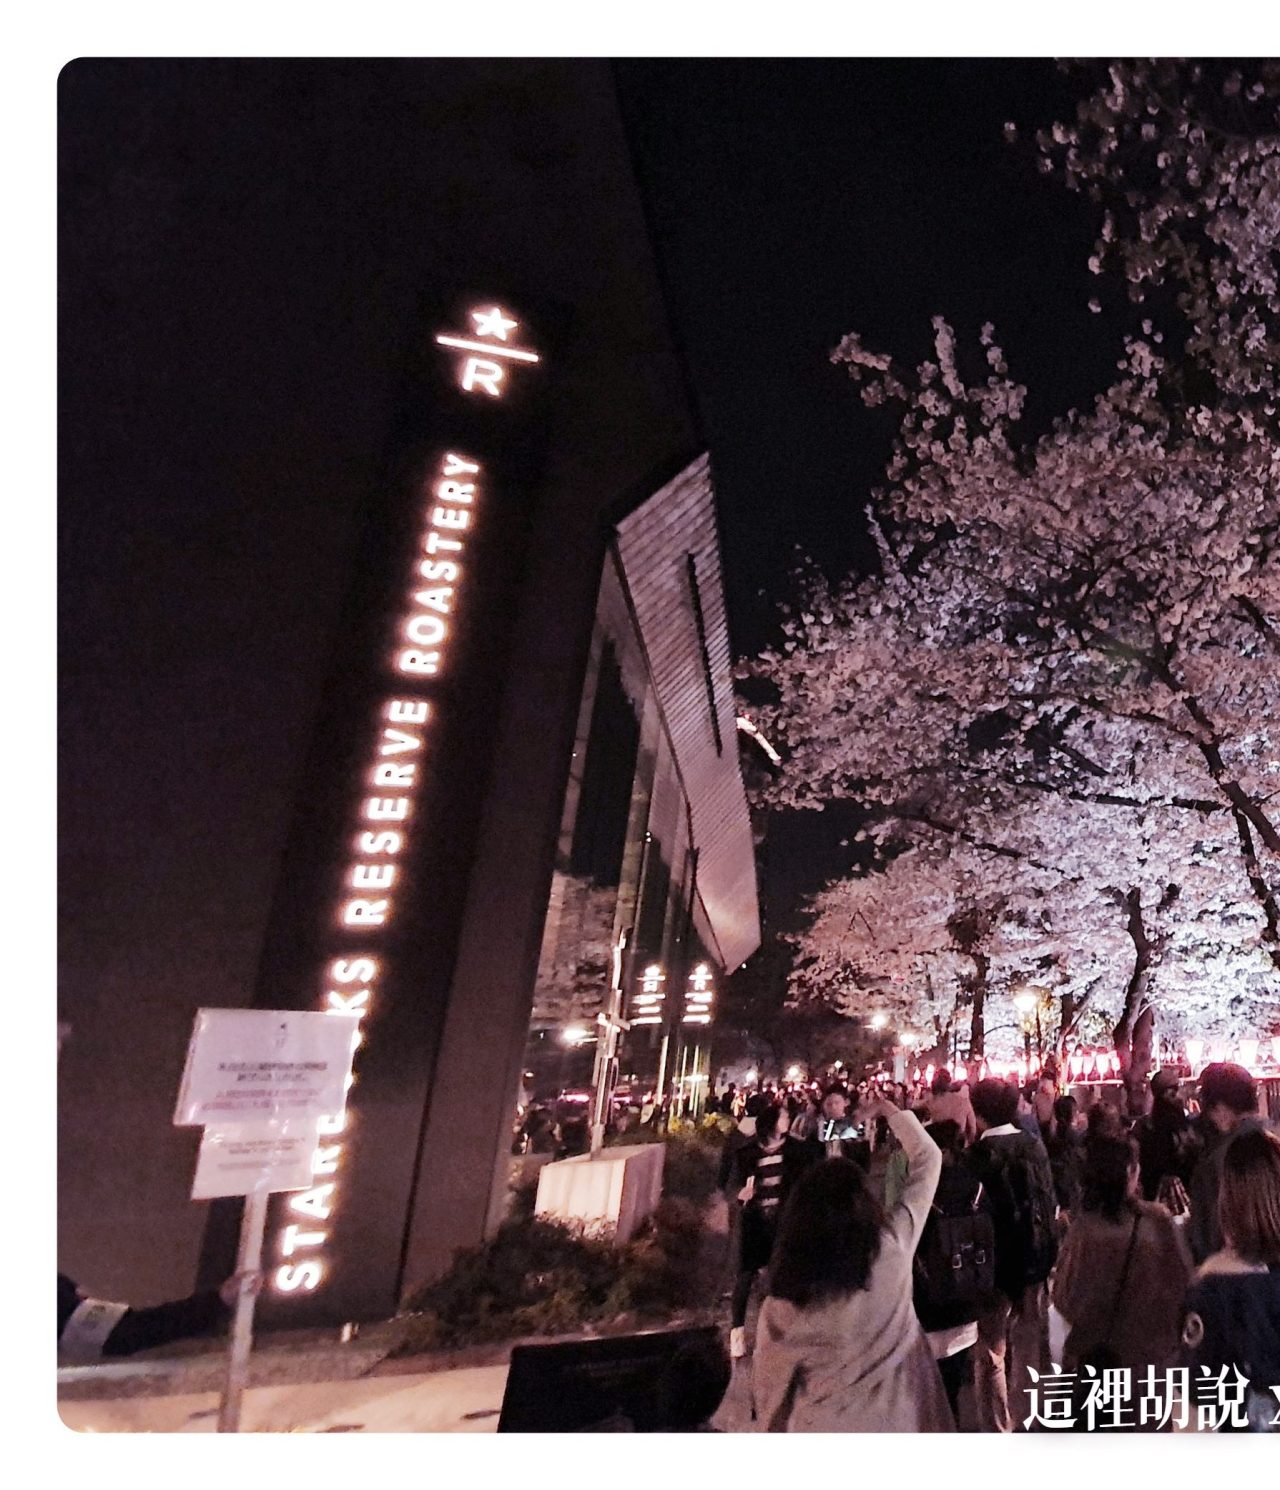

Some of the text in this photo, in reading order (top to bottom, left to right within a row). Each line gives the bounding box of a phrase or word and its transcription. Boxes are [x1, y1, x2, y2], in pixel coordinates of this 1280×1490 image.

[461, 357, 504, 396] R
[275, 453, 480, 1291] STARKS RESERVE ROASTERY
